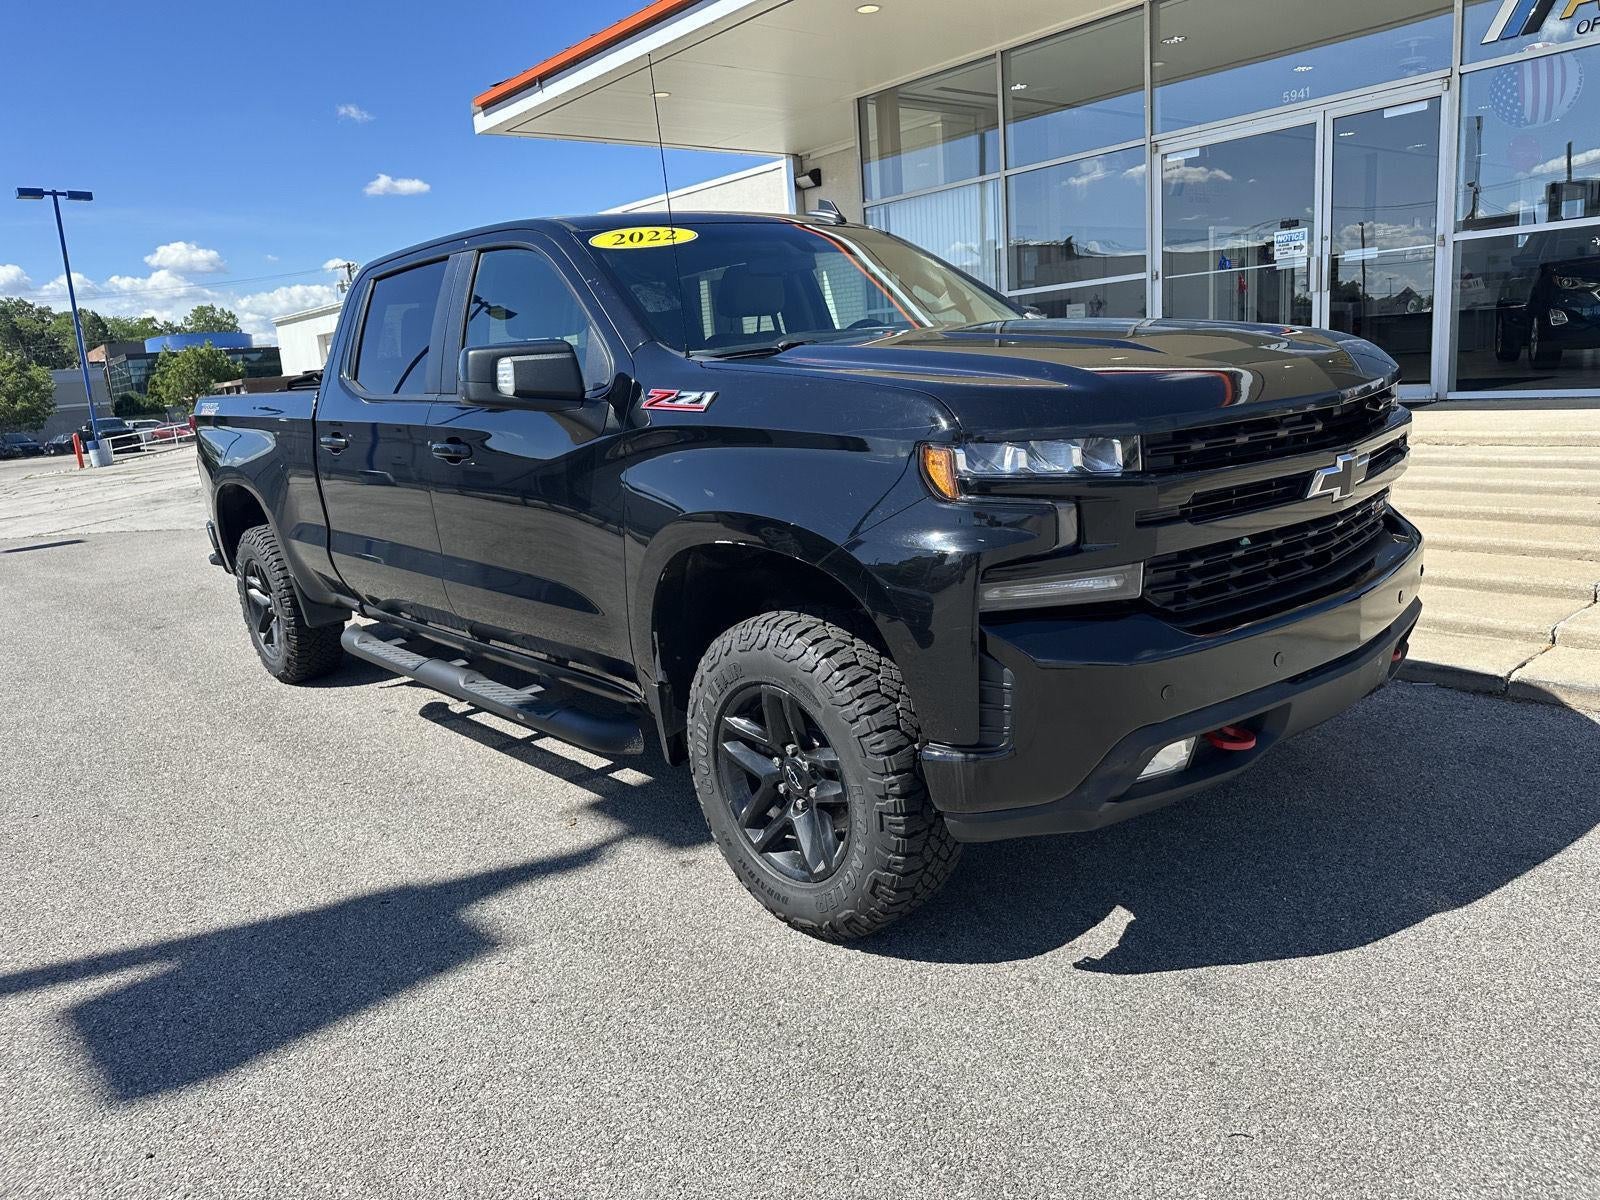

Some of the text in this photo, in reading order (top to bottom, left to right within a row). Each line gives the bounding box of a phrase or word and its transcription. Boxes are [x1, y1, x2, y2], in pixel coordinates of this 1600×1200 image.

[1282, 86, 1310, 103] 5941
[611, 229, 678, 245] 2022
[1277, 231, 1304, 243] NOTICE
[641, 388, 718, 412] Z71
